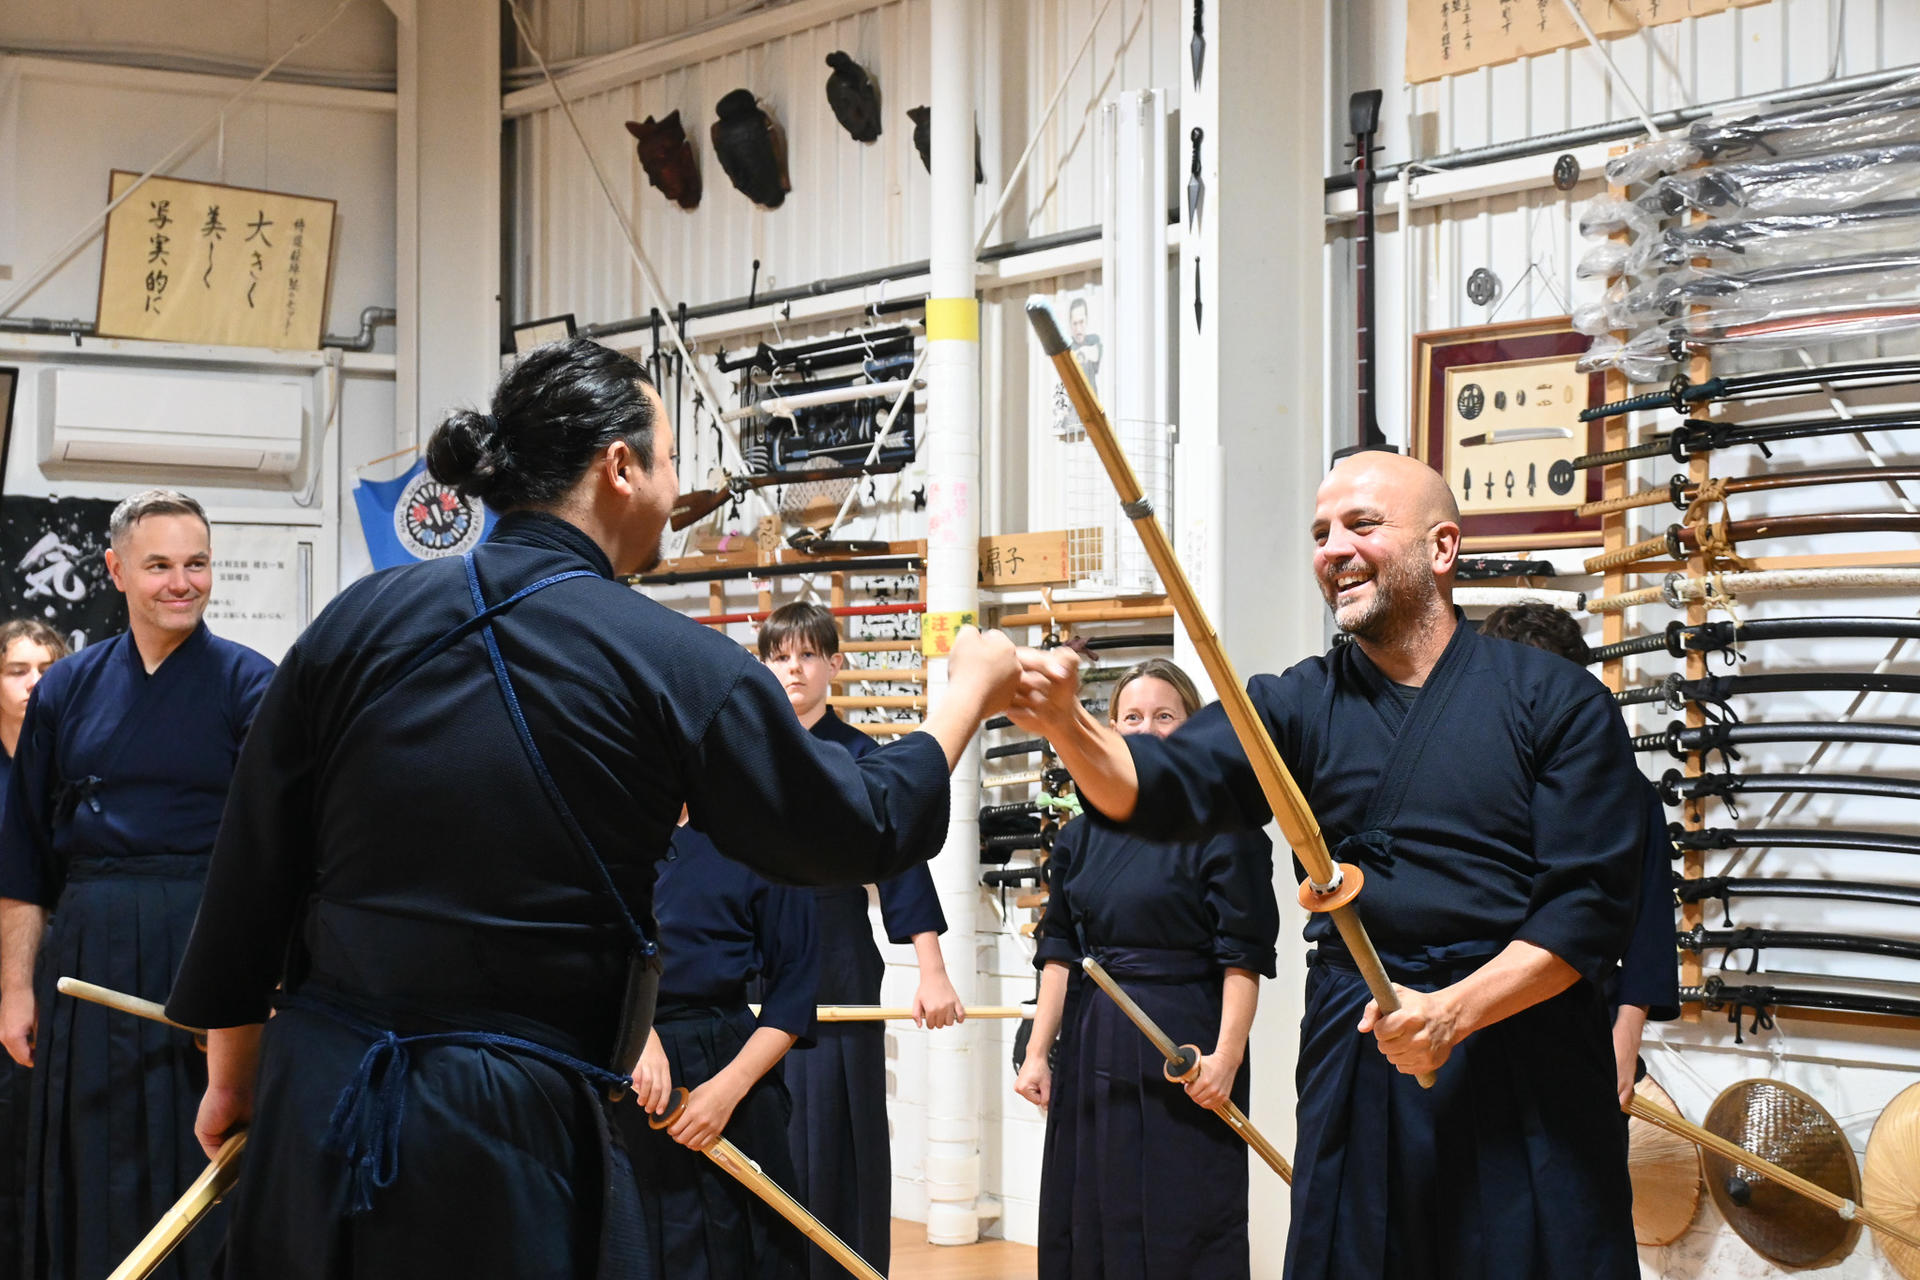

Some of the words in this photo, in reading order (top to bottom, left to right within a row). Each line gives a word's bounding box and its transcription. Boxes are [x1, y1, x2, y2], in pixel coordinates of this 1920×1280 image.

[145, 200, 173, 314] 写実的に
[201, 204, 227, 289] 美しく
[244, 209, 275, 309] 大きく
[931, 615, 951, 653] 注意
